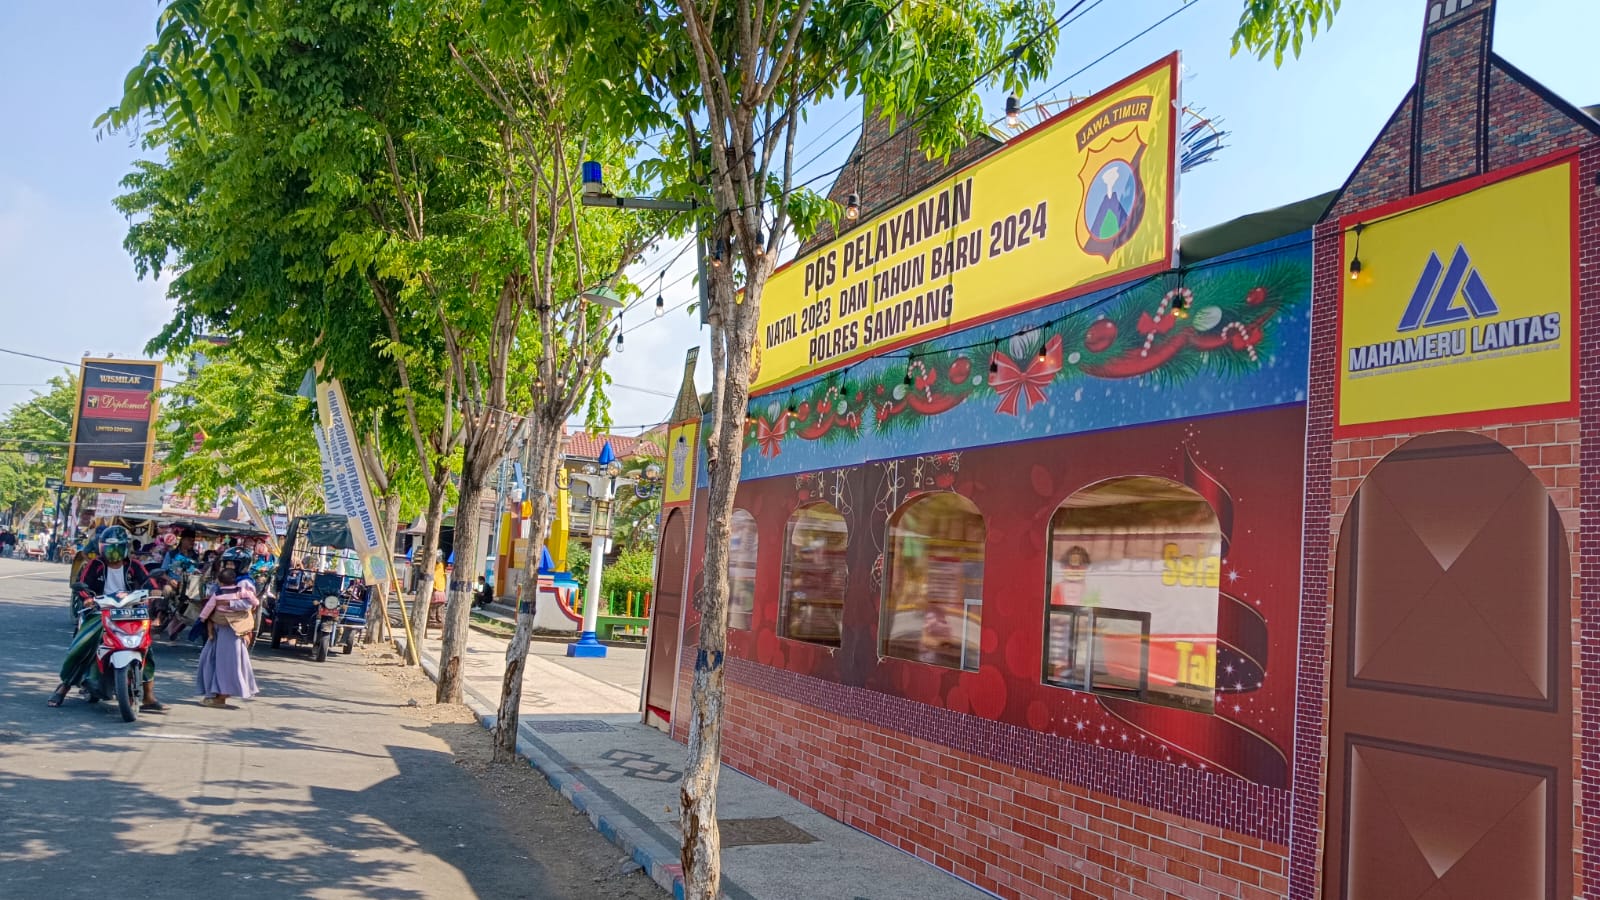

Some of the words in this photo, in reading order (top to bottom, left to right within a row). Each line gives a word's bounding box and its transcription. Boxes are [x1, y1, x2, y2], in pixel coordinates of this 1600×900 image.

[1080, 114, 1110, 145] JAWA
[1112, 102, 1148, 123] TIMUR
[804, 249, 836, 297] POS
[842, 178, 973, 278] PELAYANAN
[766, 313, 798, 350] NATAL
[801, 297, 831, 334] 2023
[839, 280, 868, 318] DAN
[872, 256, 925, 304] TAHUN
[931, 229, 983, 281] BARU
[989, 201, 1047, 258] 2024
[808, 320, 858, 365] POLRES
[863, 284, 954, 347] SAMPANG
[1348, 327, 1466, 372] MAHAMERU
[1471, 312, 1561, 353] LANTAS
[100, 374, 141, 385] WISMILAK
[101, 394, 148, 413] Diplomat
